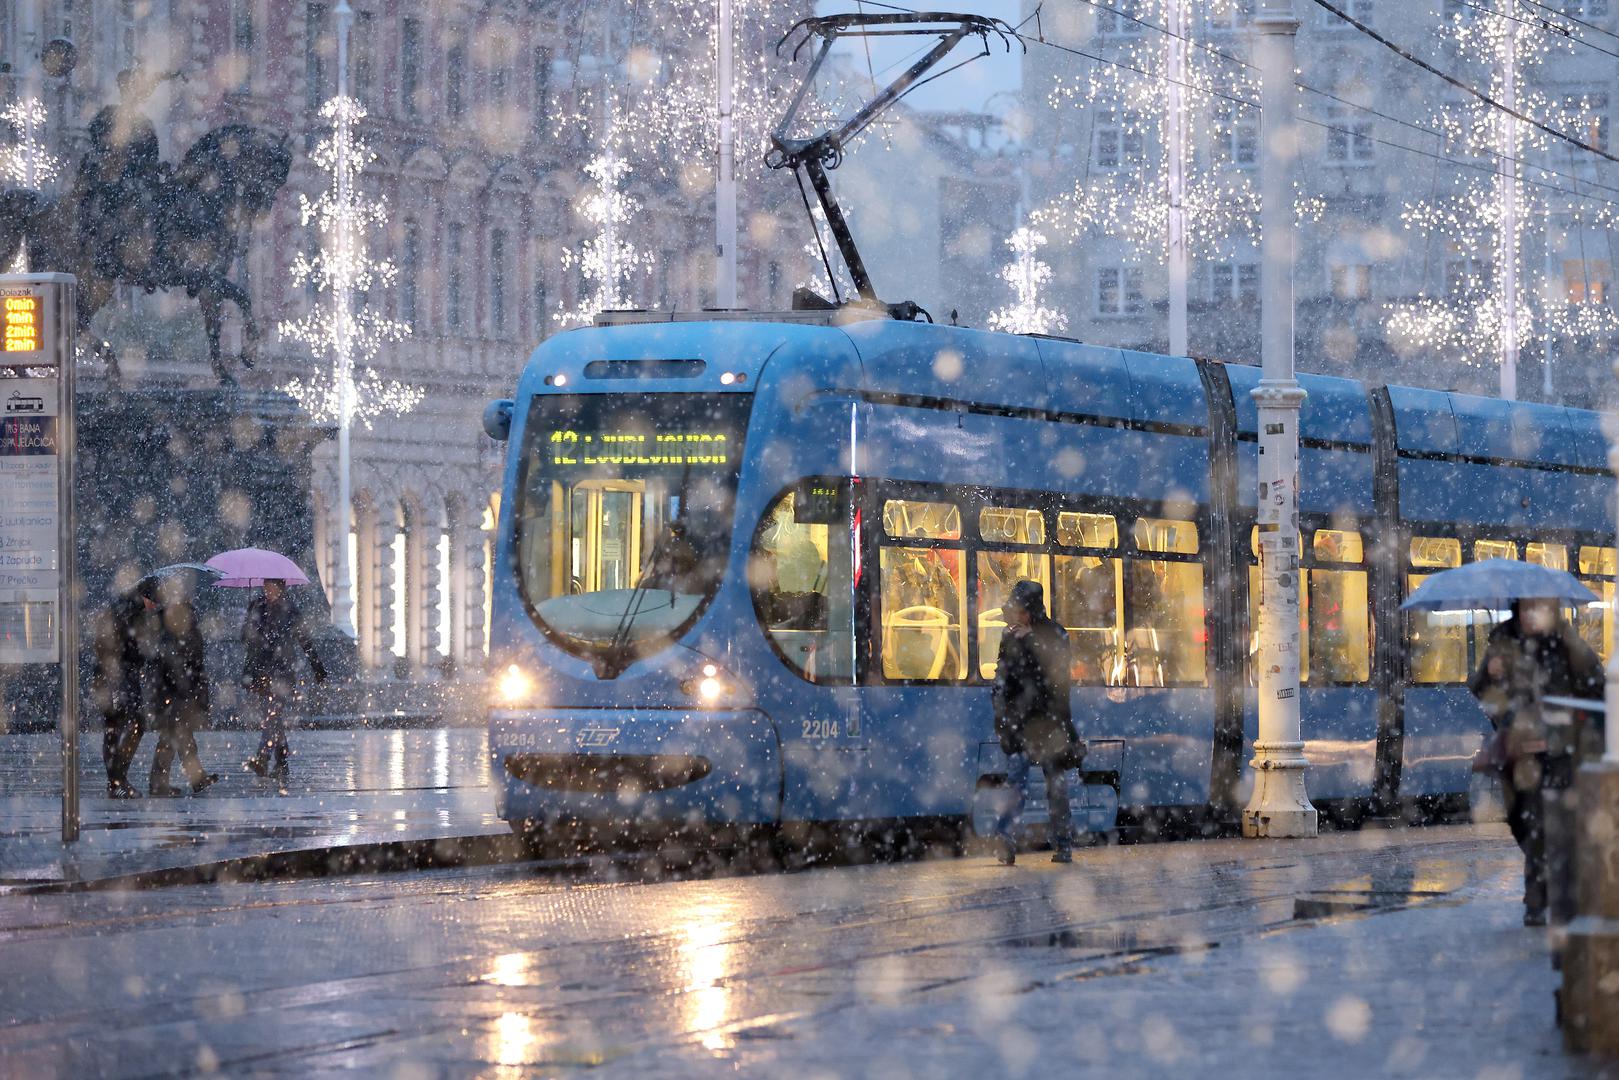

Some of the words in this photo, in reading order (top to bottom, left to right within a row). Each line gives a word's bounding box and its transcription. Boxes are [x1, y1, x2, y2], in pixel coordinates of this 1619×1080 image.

[0, 288, 32, 296] Dolazak
[6, 298, 35, 311] 0min
[6, 311, 34, 324] 1min
[6, 325, 35, 338] 2min
[6, 338, 35, 351] 2min
[19, 423, 41, 433] BANA
[551, 430, 578, 464] 12
[801, 719, 841, 738] 2204
